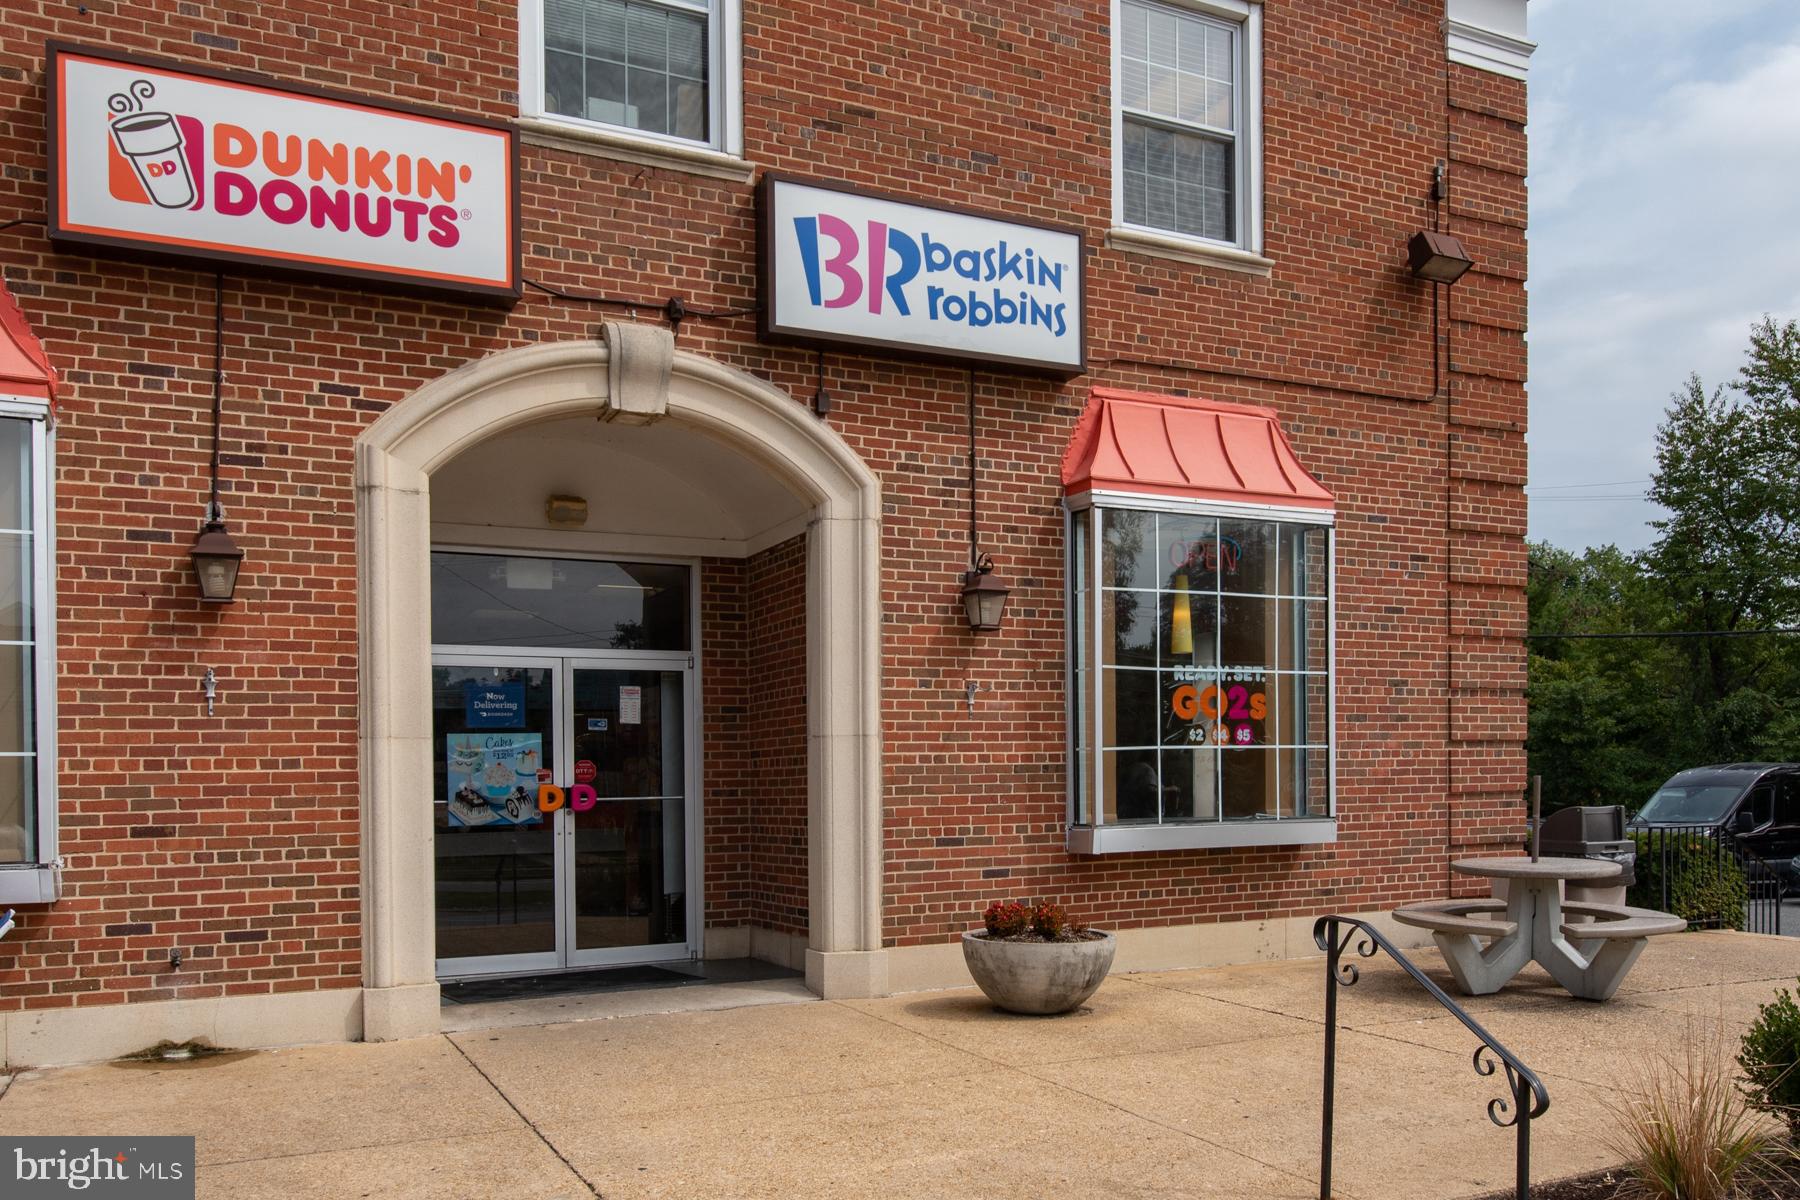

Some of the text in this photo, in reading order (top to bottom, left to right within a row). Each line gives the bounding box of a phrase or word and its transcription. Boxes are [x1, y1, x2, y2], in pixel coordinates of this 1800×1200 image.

[146, 160, 177, 178] DD
[213, 122, 472, 203] DUNKIN'
[214, 170, 461, 249] DONUTS
[793, 213, 921, 317] BR
[1169, 540, 1237, 572] OPEN
[486, 692, 505, 700] Now
[473, 701, 518, 711] Delivering
[485, 736, 514, 750] Cakes
[1189, 728, 1204, 742] $2
[1236, 728, 1251, 742] $5
